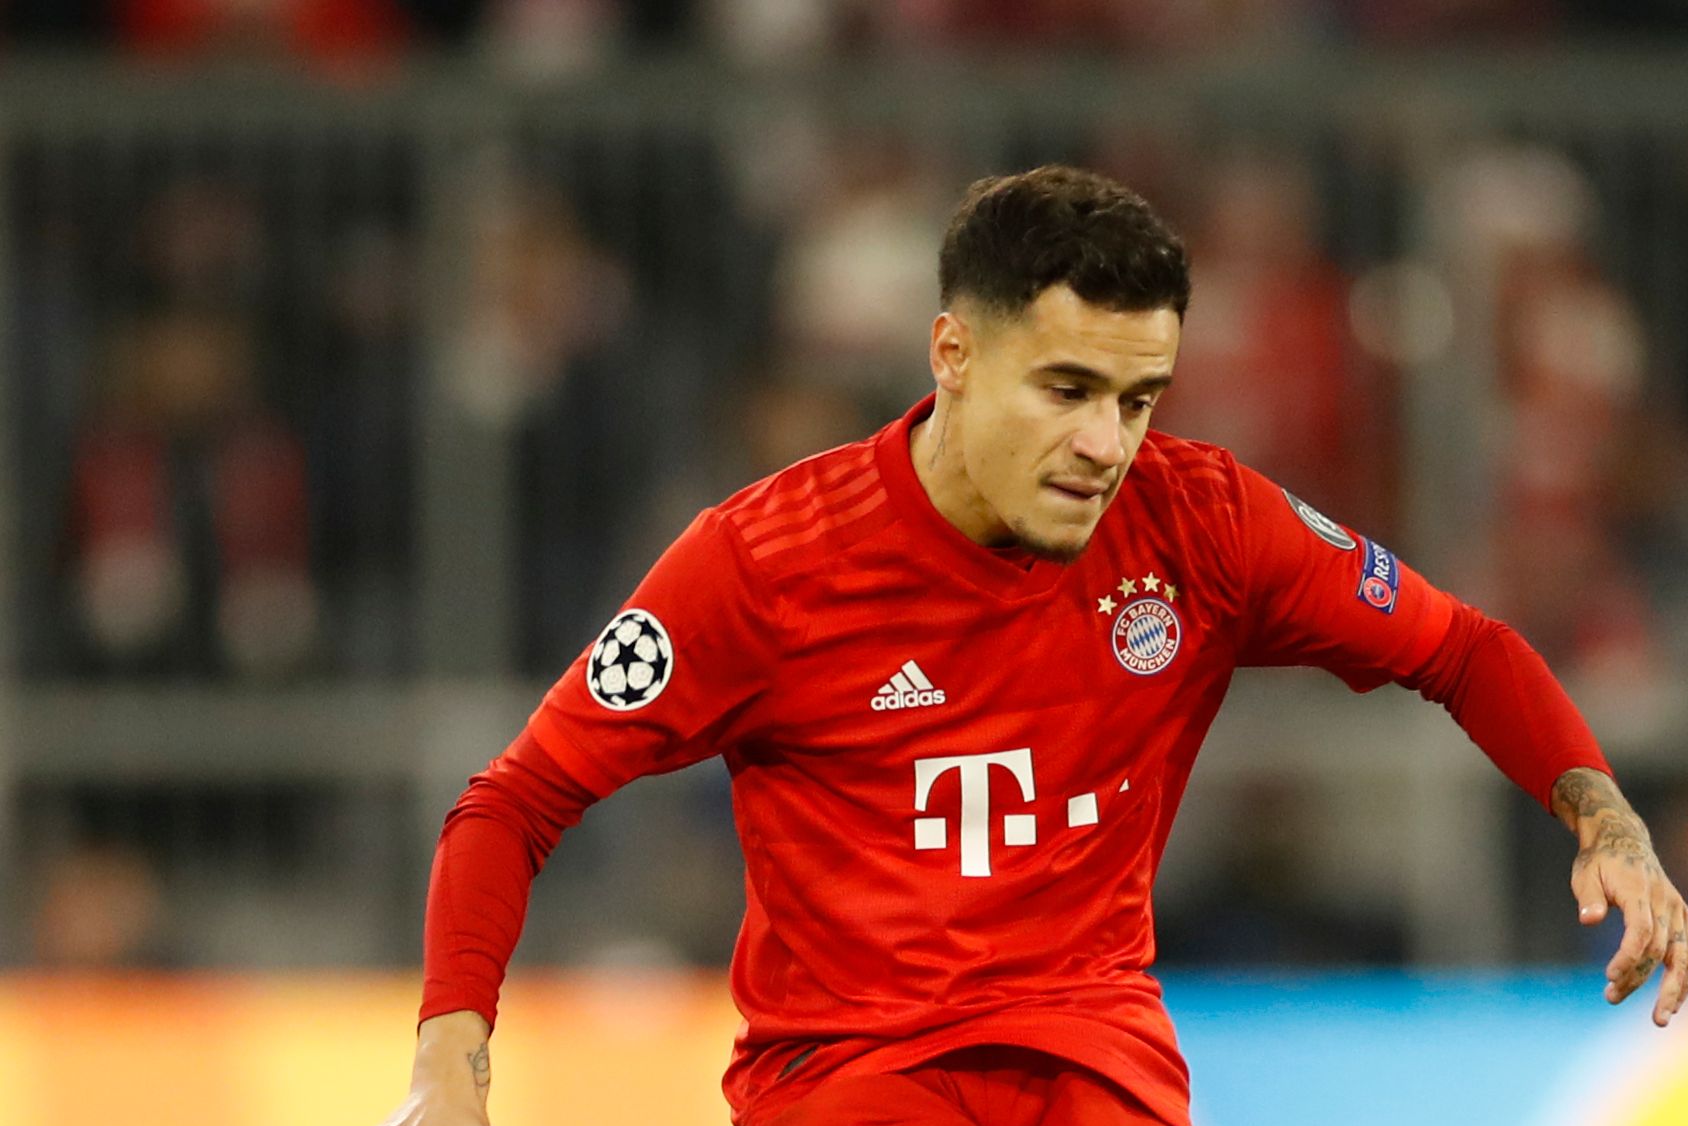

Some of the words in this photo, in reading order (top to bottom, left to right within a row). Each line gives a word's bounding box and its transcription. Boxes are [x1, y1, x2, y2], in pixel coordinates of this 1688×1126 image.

[1117, 618, 1130, 636] FC
[1128, 603, 1173, 627] BAYERN
[870, 689, 946, 711] adidas
